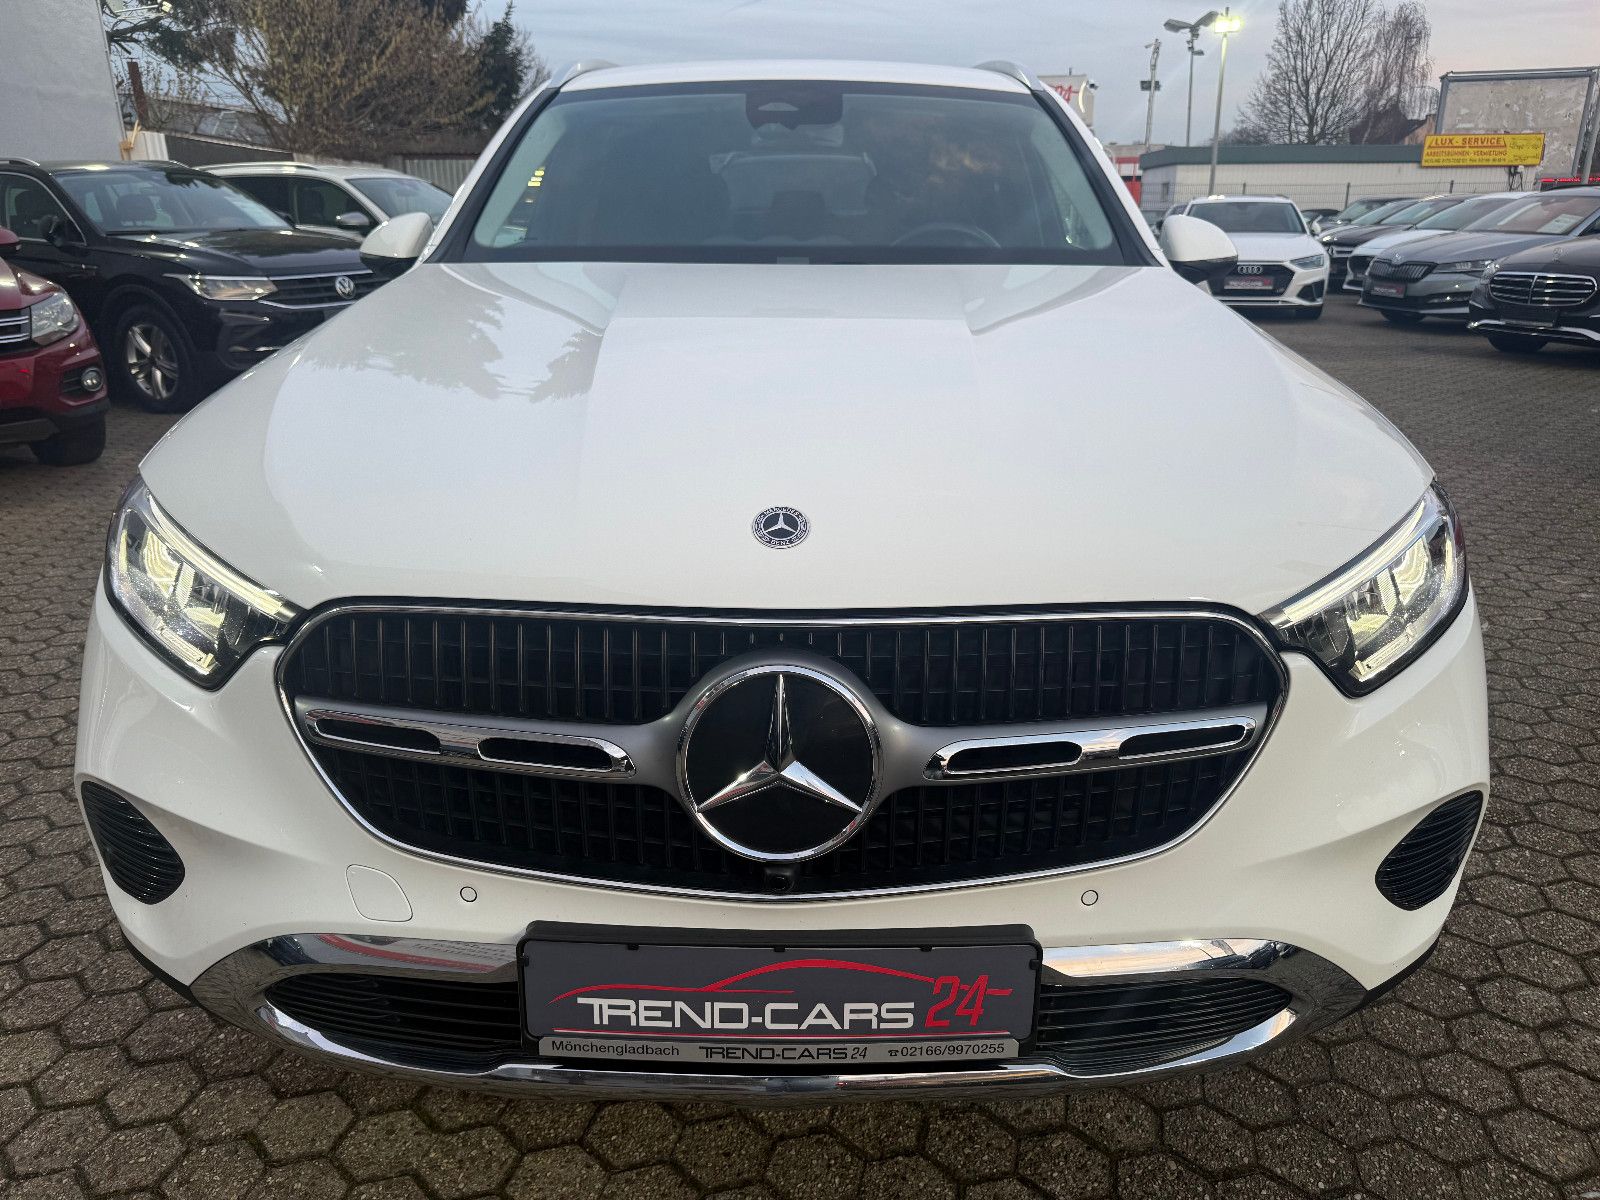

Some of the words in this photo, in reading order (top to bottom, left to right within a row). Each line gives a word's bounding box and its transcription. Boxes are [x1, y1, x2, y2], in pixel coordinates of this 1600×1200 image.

[1435, 137, 1454, 145] LUX
[1462, 137, 1502, 145] SERVICE
[577, 997, 915, 1030] TREND-CARS
[925, 975, 989, 1027] 24
[551, 1040, 680, 1057] Mönchengladbach
[699, 1046, 848, 1060] TREND-CARS
[850, 1046, 868, 1060] 24
[900, 1043, 1005, 1057] 02166/9970255
